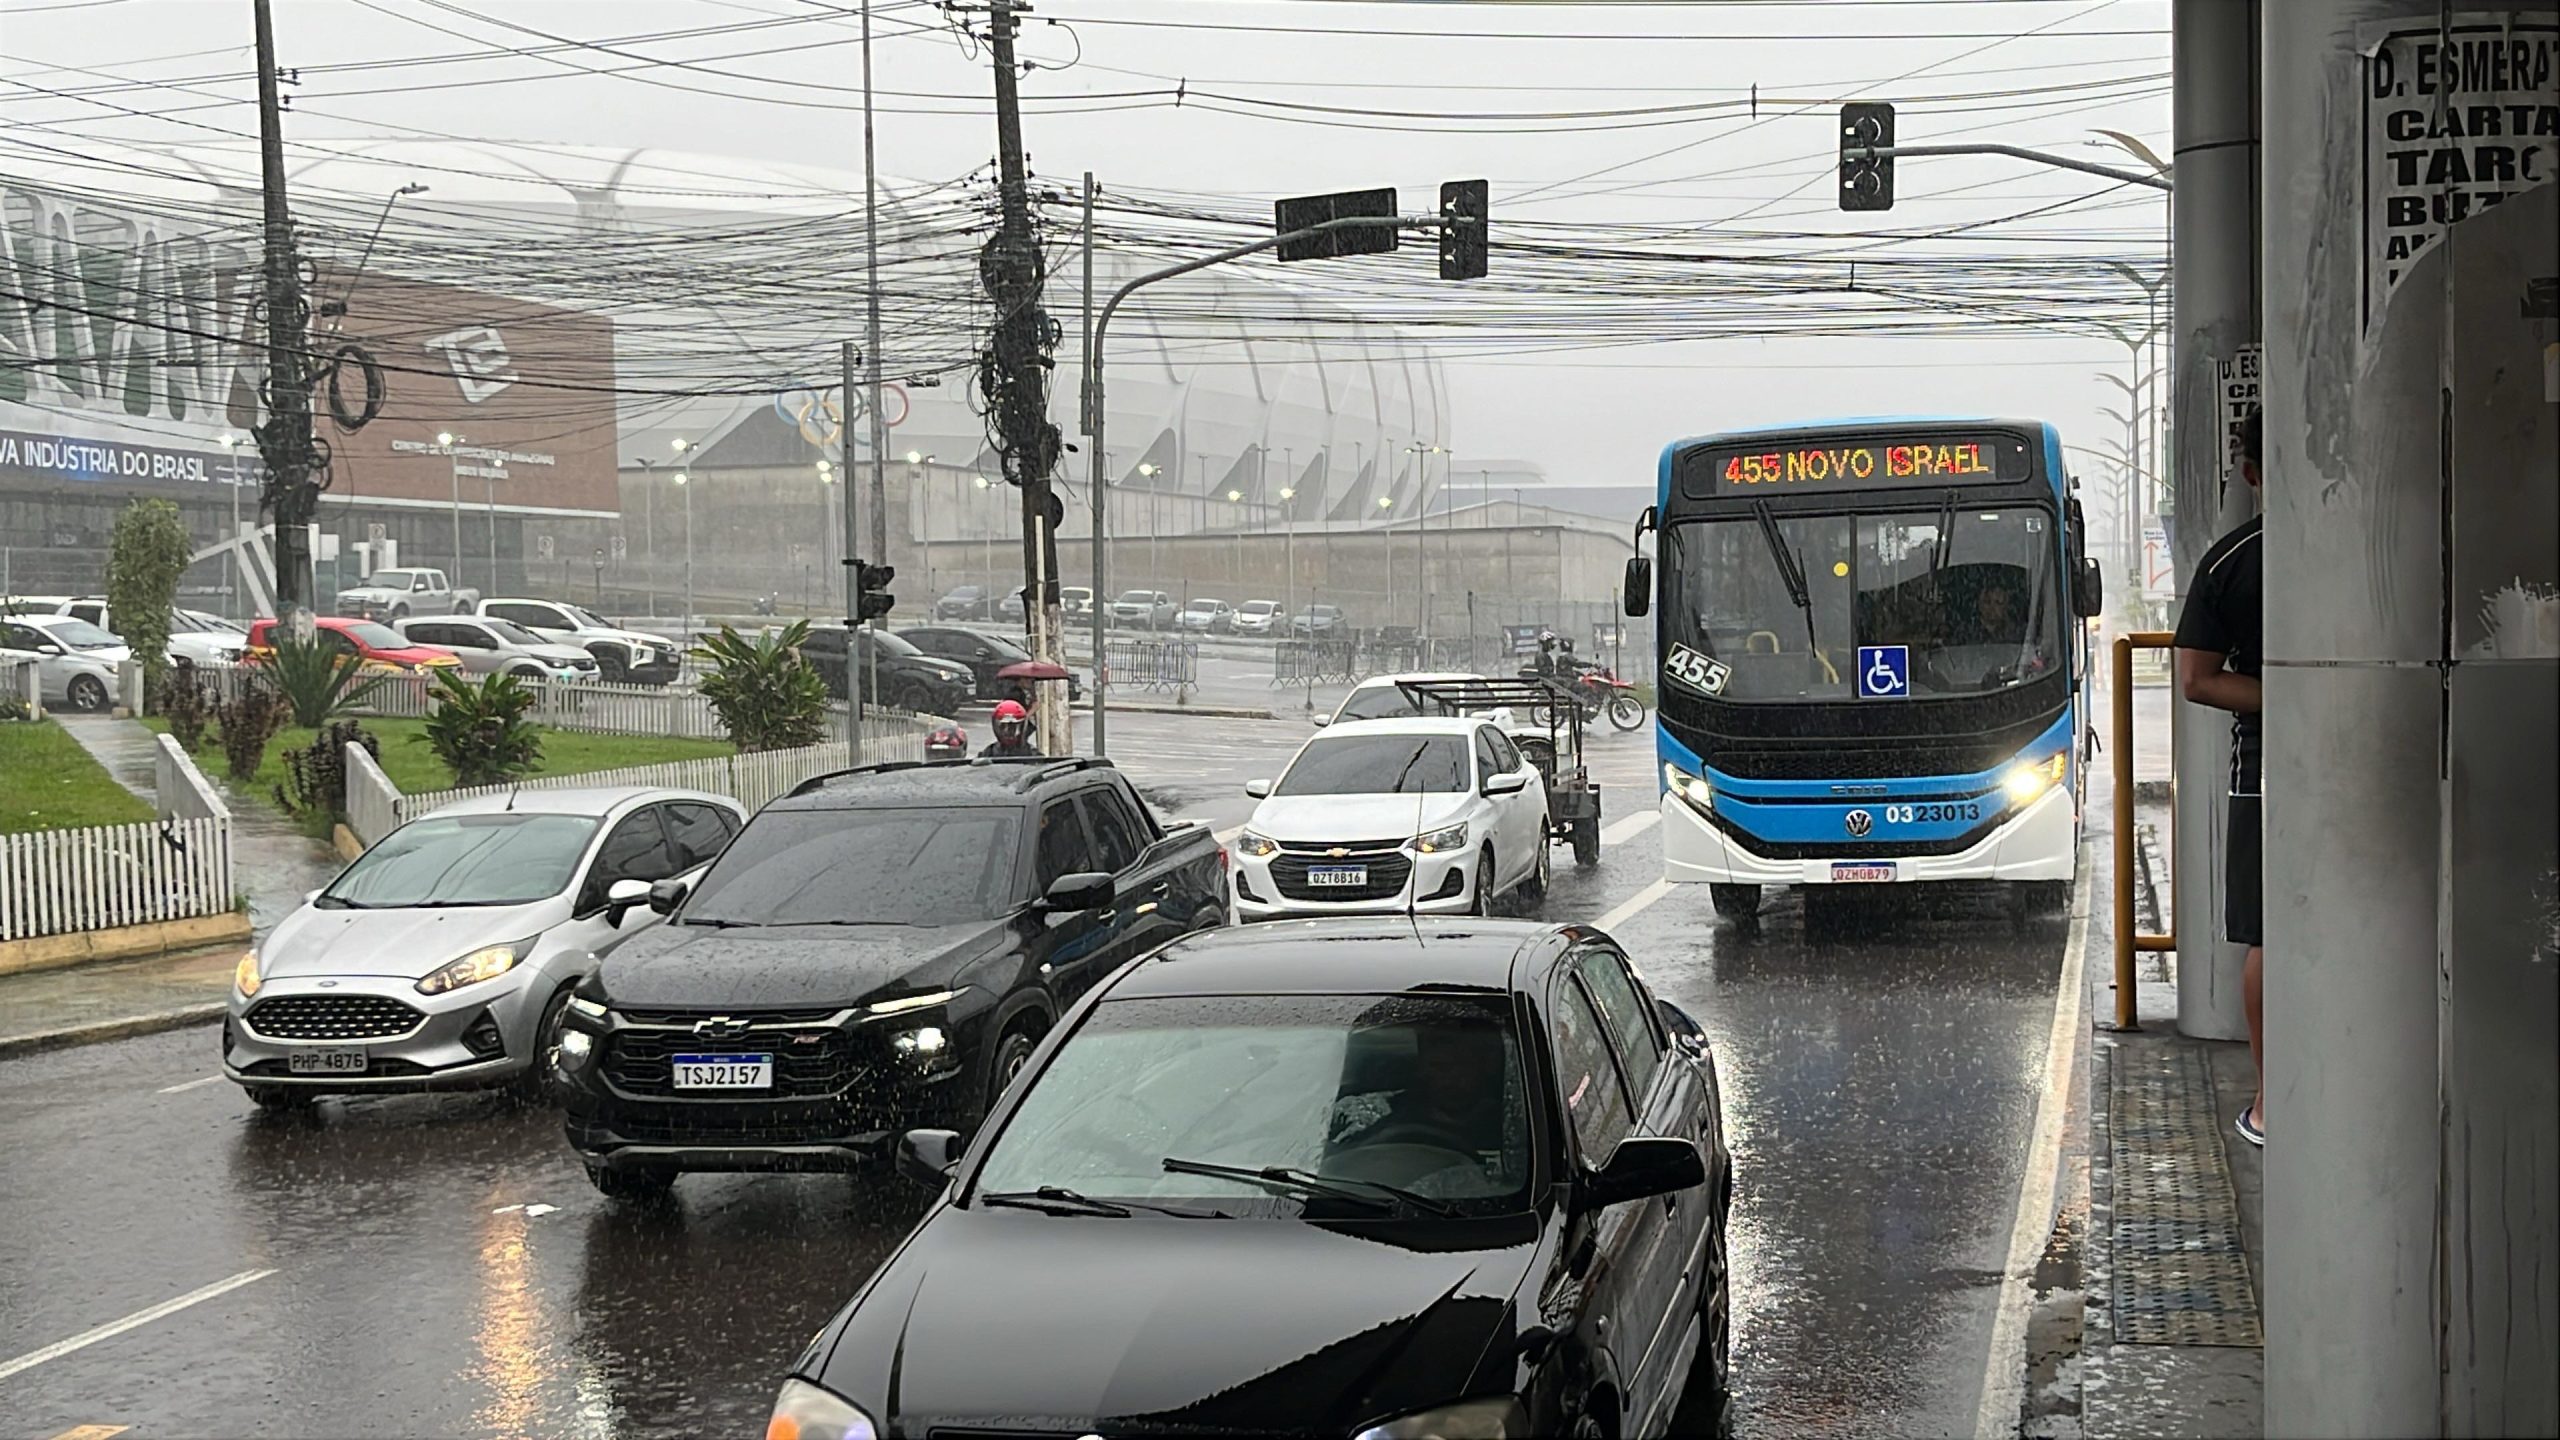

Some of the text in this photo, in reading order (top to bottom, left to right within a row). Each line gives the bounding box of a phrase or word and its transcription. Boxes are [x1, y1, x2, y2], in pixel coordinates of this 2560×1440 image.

[2374, 40, 2559, 99] D. ESMERA
[24, 438, 119, 475] INDÚSTRIA
[122, 450, 149, 477] DO
[153, 454, 209, 482] BRASIL
[1725, 443, 1989, 485] 455 NOVO ISRAEL
[1668, 649, 1727, 692] 455
